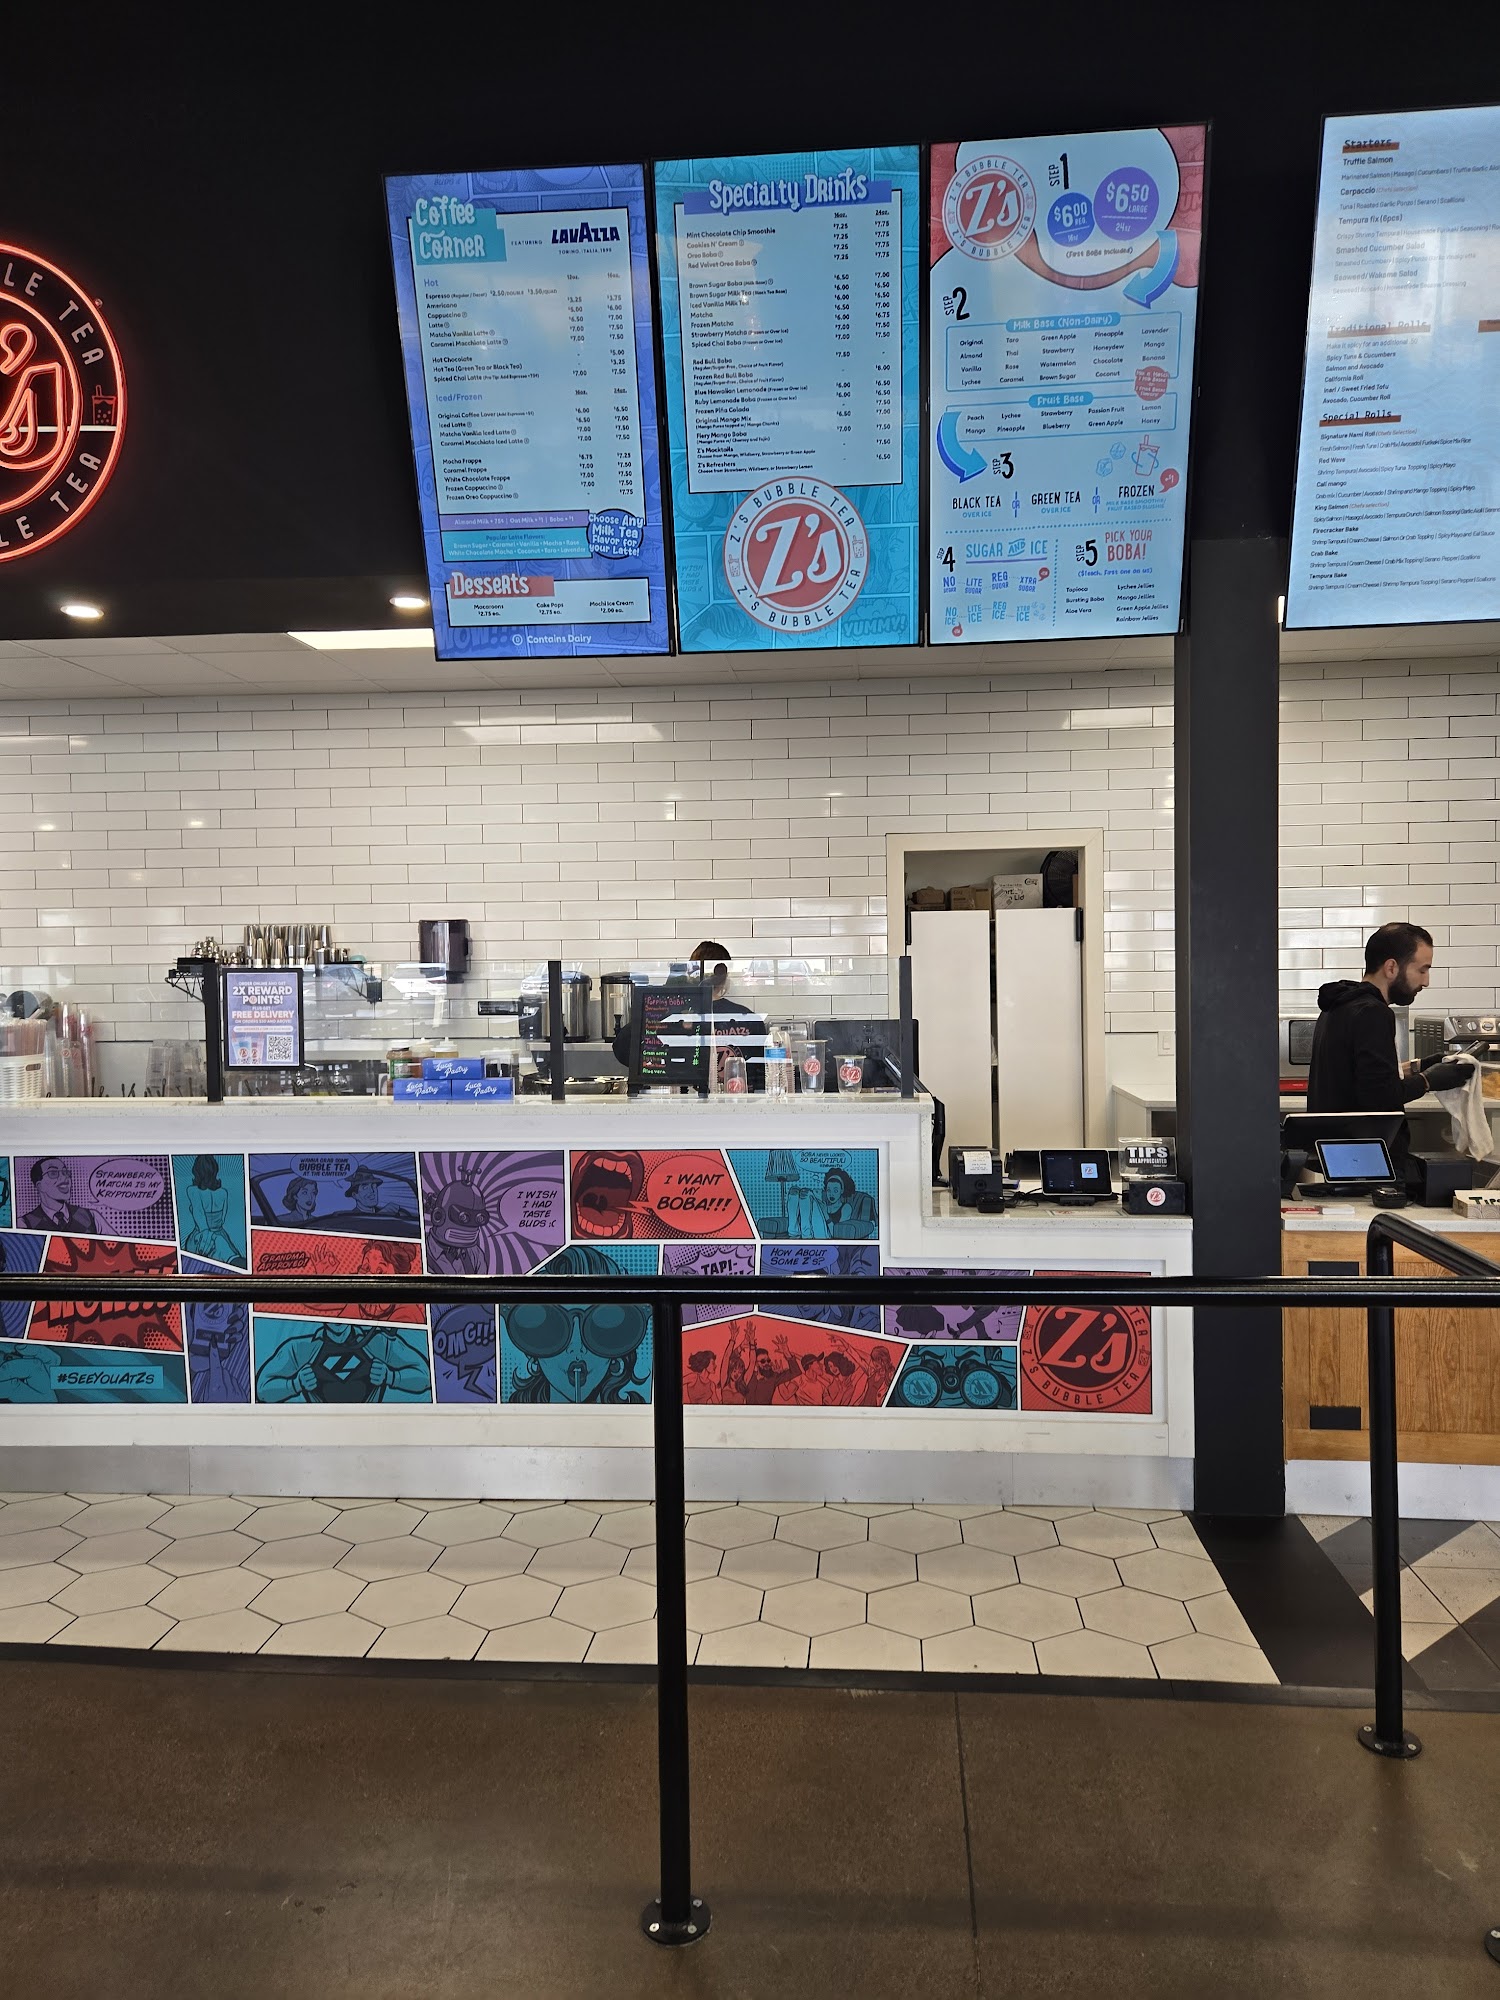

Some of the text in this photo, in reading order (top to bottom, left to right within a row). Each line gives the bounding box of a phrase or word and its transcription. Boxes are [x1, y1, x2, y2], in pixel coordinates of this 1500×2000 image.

[1344, 139, 1392, 149] Starters
[1343, 156, 1393, 166] Truffle Salmon
[965, 160, 1007, 177] BUBBLE
[1012, 169, 1028, 189] TEA
[1049, 153, 1069, 189] STEP 1
[710, 168, 867, 213] Specialty Drinks
[1340, 187, 1375, 196] Carpaccio
[416, 195, 476, 227] Coffee
[965, 180, 1020, 238] Z's
[552, 222, 620, 244] LAVAZZA
[424, 279, 439, 288] Hot
[944, 287, 969, 320] STEP 2
[427, 312, 462, 320] Cappuccino
[1014, 316, 1113, 330] Milk Base (Non-Dairy)
[58, 300, 104, 365] TEA
[436, 393, 482, 402] Iced/Frozen
[1038, 394, 1084, 405] Fruit Base
[1323, 410, 1392, 422] Special Rolls
[993, 453, 1014, 478] STEP 3
[49, 451, 101, 513] TEA
[1119, 485, 1155, 497] FROZEN
[953, 496, 1001, 509] BLACK TEA
[1032, 492, 1081, 505] GREEN TEA
[753, 483, 820, 509] BUBBLE
[830, 496, 854, 528] TEA
[589, 514, 644, 527] Choose Any
[592, 525, 638, 538] Milk Tea
[1105, 530, 1152, 543] PICK YOUR
[593, 535, 637, 547] Flavor for
[590, 545, 639, 556] your Latte!
[966, 540, 1047, 558] SUGAR AND ICE
[1076, 539, 1098, 566] STEP 5
[1108, 545, 1146, 562] BOBA!
[756, 513, 844, 597] Z's
[937, 546, 955, 572] STEP 4
[452, 573, 529, 595] Desserts
[768, 606, 833, 626] BUBBLE
[839, 569, 860, 599] TEA
[527, 634, 591, 644] Contains Dairy
[233, 986, 292, 995] 2X REWARD
[436, 1062, 453, 1071] Luca
[444, 1066, 468, 1077] Pastry
[406, 1082, 423, 1091] Luca
[415, 1087, 439, 1097] Pastry
[465, 1082, 482, 1091] Luca
[473, 1087, 497, 1097] Pastry
[1127, 1147, 1168, 1157] TIPS
[299, 1163, 331, 1171] BUBBLE
[95, 1170, 157, 1179] STRAWBERRY
[664, 1174, 725, 1185] I WANT
[96, 1180, 133, 1188] MATCHA
[148, 1180, 162, 1188] MY
[97, 1189, 157, 1199] KRYPTONITE!
[516, 1190, 558, 1200] I WISH
[682, 1186, 699, 1196] MY
[523, 1200, 552, 1209] I HAD
[657, 1197, 730, 1211] BOBA!!!
[523, 1210, 552, 1218] TASTE
[519, 1220, 546, 1229] BUDS
[260, 1253, 307, 1262] GRANDMA
[770, 1248, 827, 1257] HOW ABOUT
[257, 1260, 308, 1270] APPROVED!
[770, 1256, 799, 1266] SOME
[1040, 1307, 1131, 1375] Z's
[1041, 1380, 1104, 1406] BUBBLE
[1115, 1373, 1140, 1397] TEA
